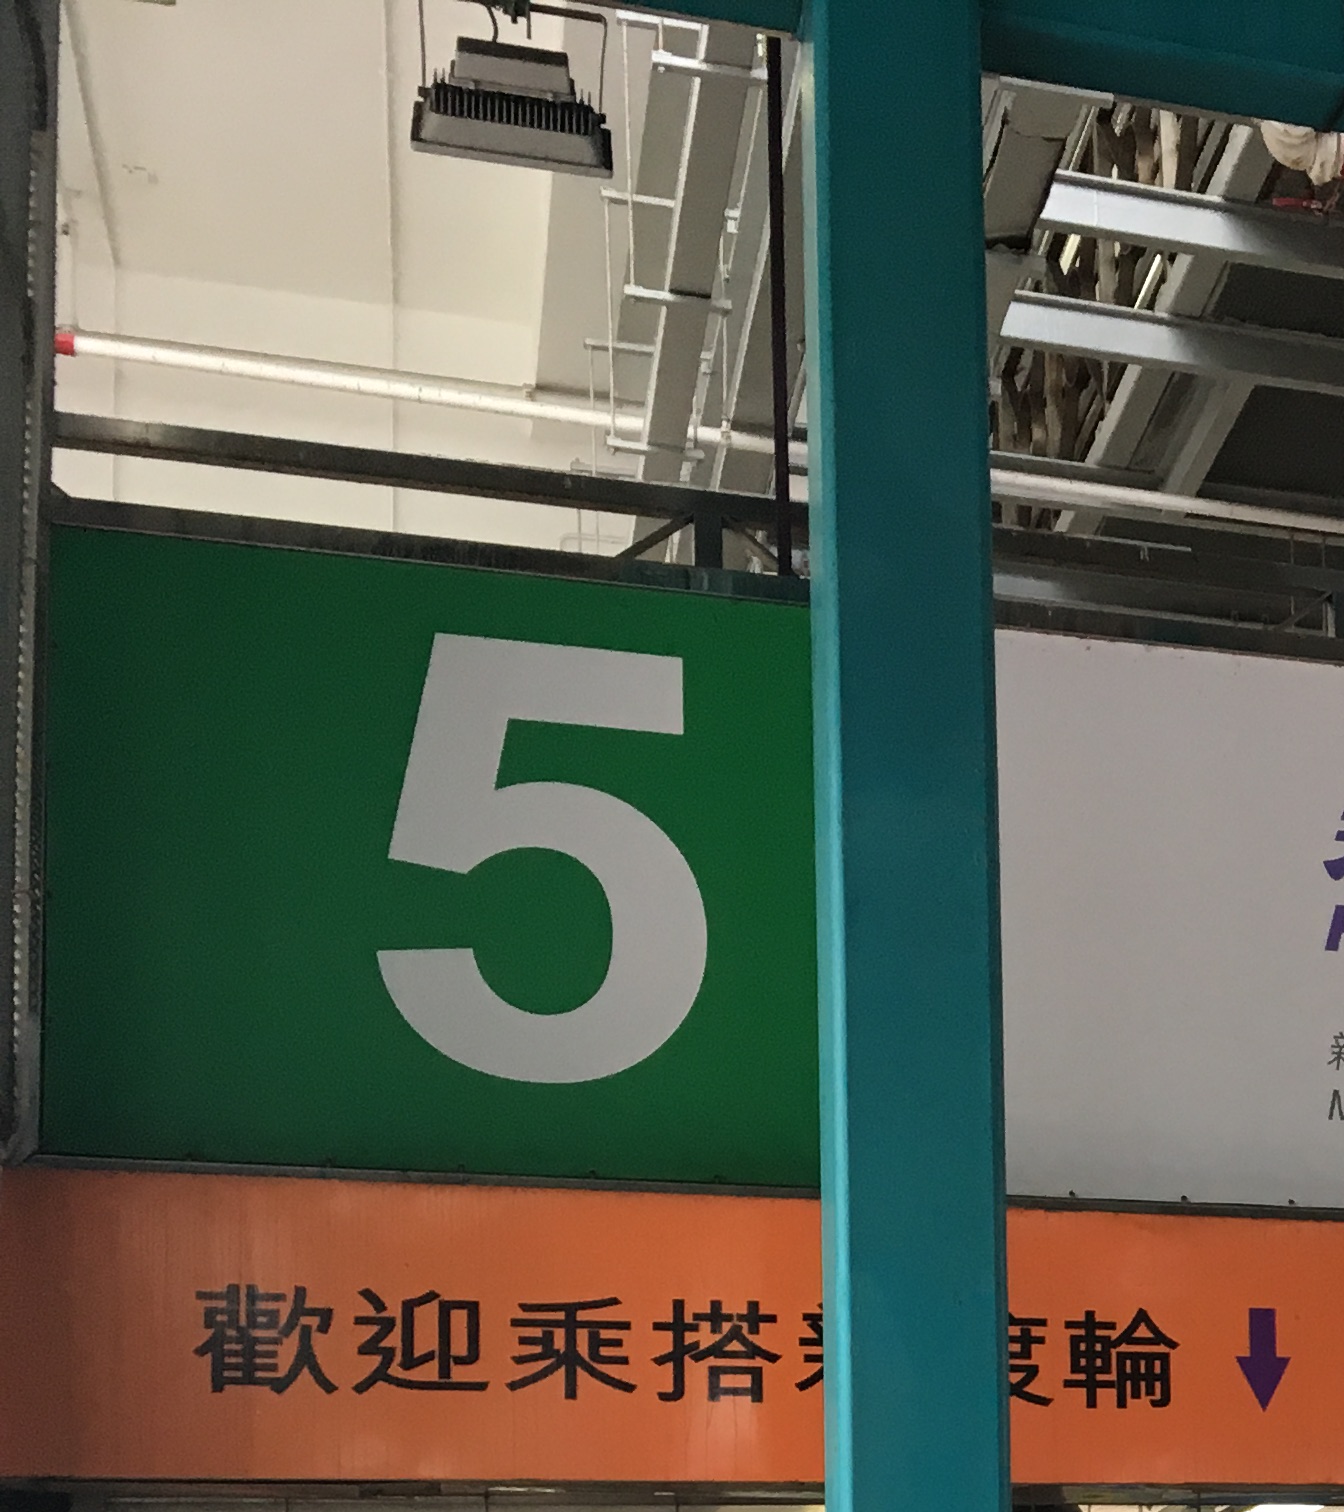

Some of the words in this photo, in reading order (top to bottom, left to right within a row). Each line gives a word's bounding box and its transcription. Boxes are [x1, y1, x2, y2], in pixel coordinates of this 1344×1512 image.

[377, 633, 708, 1084] 5
[194, 1284, 1181, 1410] 歡迎乘搭輪
